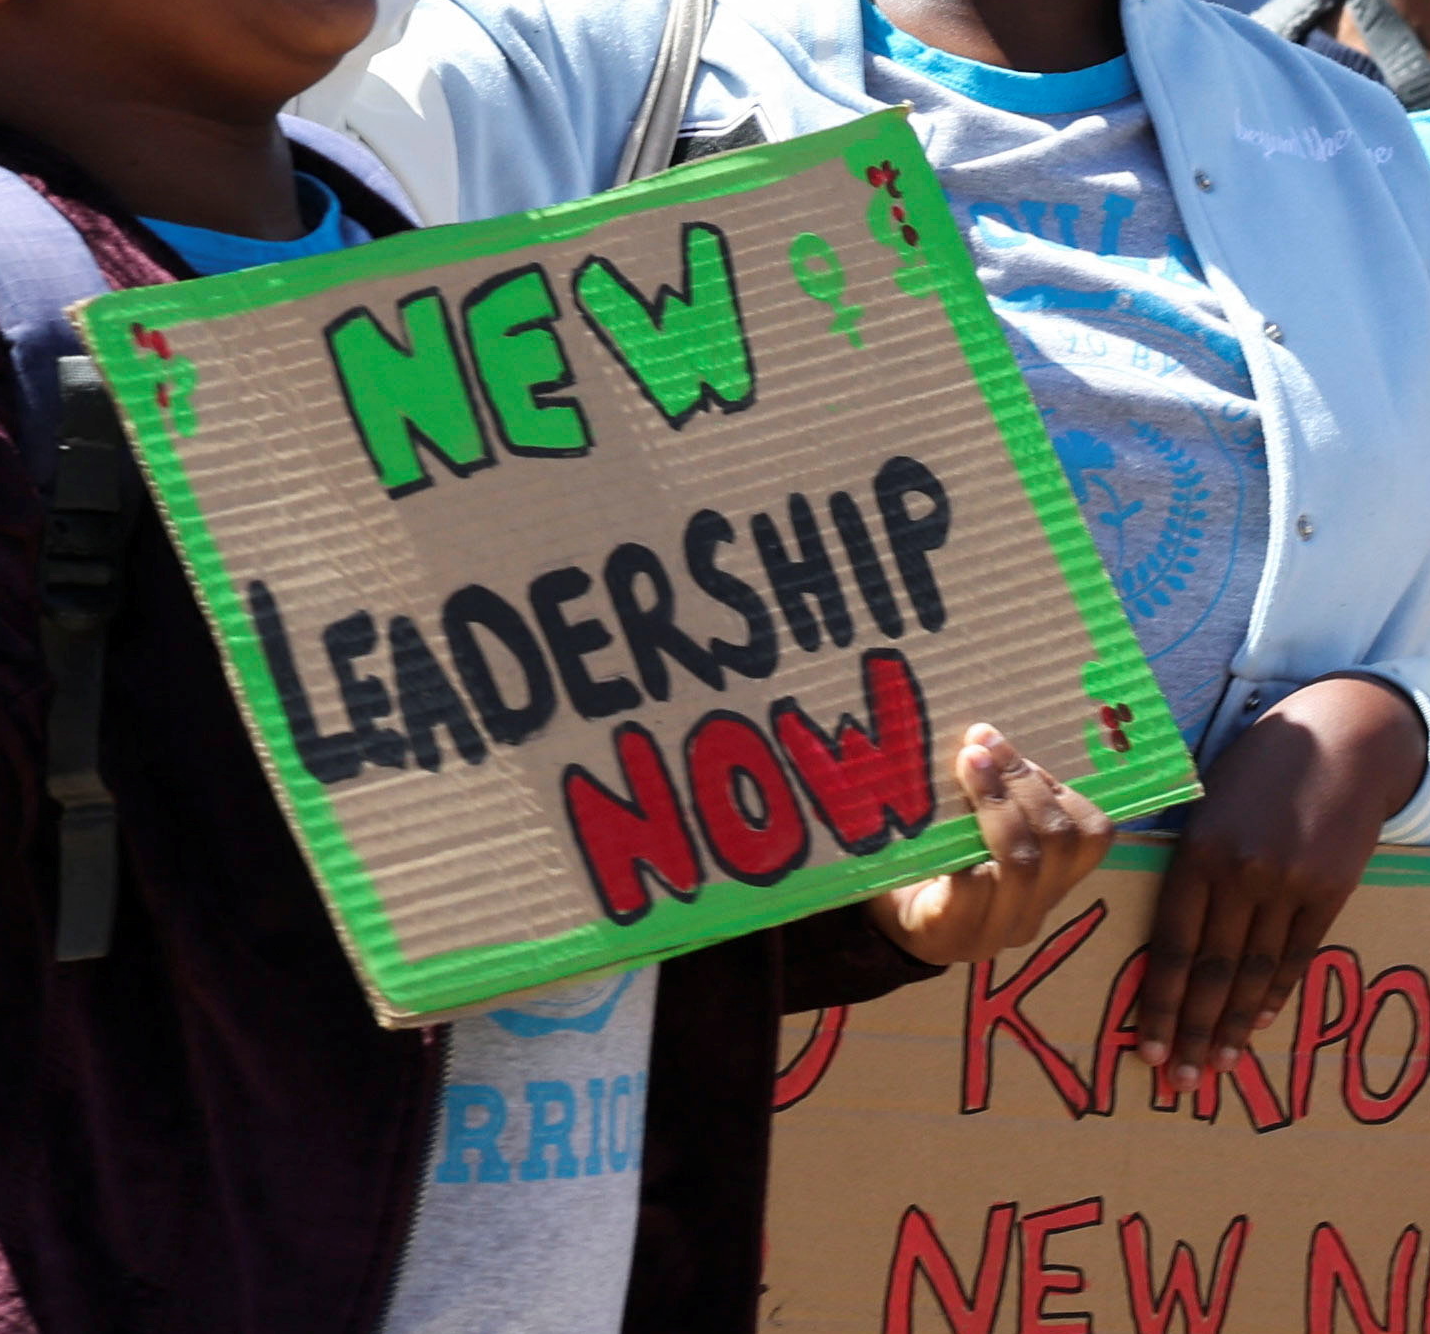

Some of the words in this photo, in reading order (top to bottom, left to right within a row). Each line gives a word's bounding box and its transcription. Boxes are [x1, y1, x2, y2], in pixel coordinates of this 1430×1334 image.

[324, 221, 755, 497] NEW
[247, 457, 952, 783] LEADERSHIP
[561, 648, 936, 925] NOW
